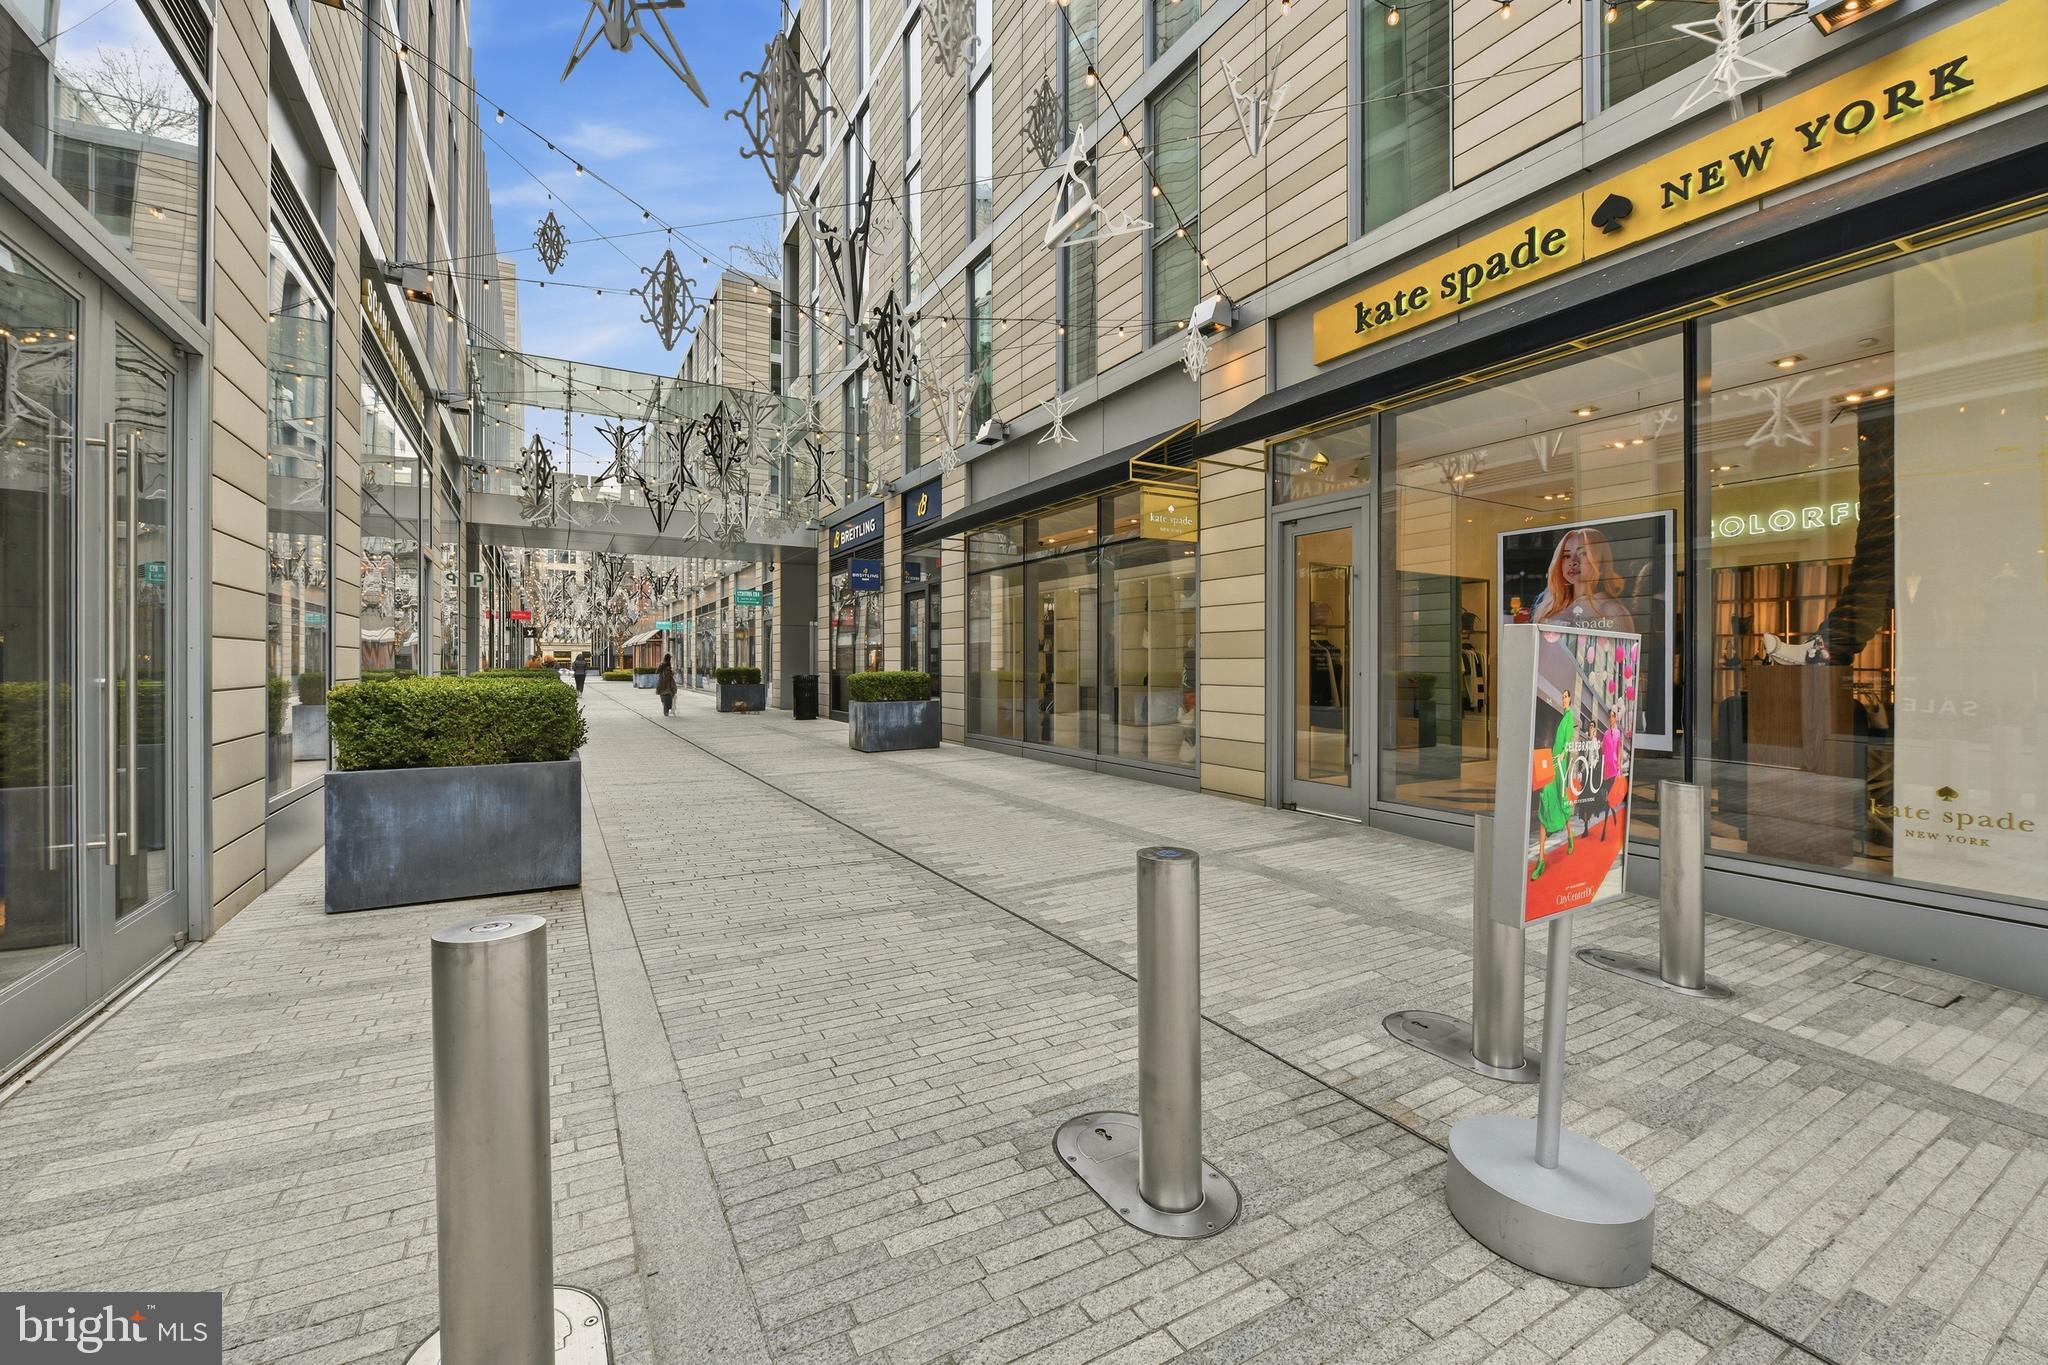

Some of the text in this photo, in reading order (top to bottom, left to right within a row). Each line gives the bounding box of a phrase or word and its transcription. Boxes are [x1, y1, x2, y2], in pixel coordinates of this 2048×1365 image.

[1355, 55, 1975, 334] kate spade NEW YORK
[840, 518, 876, 545] BREITLING
[1150, 512, 1193, 527] kate spade
[1711, 502, 1861, 539] OLORF
[473, 574, 484, 586] P
[1575, 617, 1614, 629] spade
[1557, 754, 1605, 798] YOU
[1870, 798, 2035, 832] kate spade
[1905, 829, 1990, 847] NEW YORK
